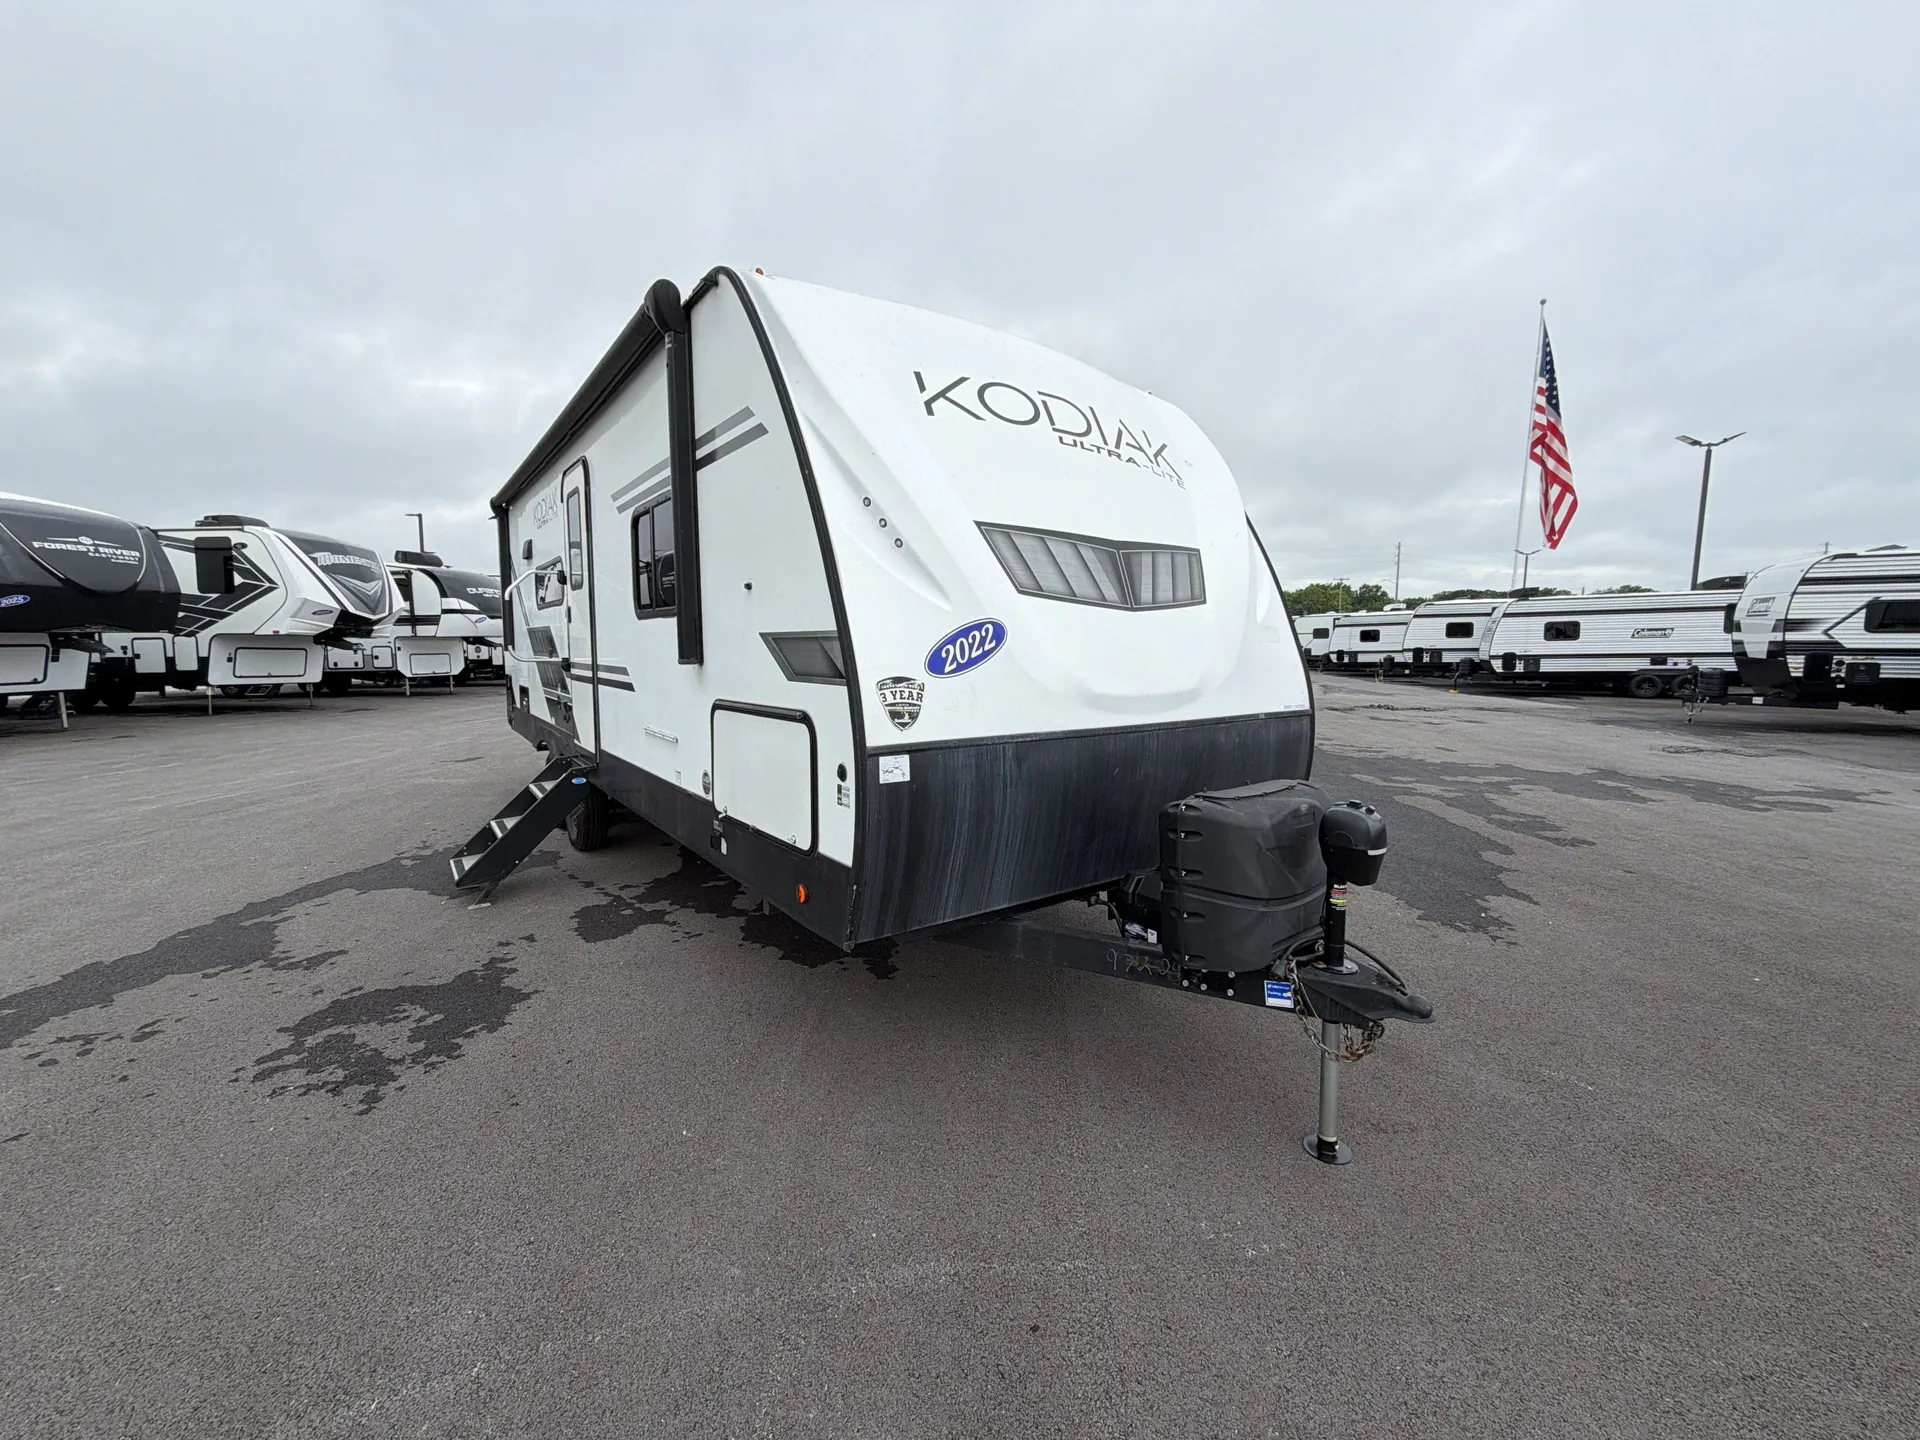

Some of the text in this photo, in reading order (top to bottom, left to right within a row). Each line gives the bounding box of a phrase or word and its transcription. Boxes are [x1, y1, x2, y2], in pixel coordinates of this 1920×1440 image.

[912, 370, 1182, 480] KODIAK
[1058, 435, 1186, 490] ULTRA-LITE
[533, 487, 559, 526] KODIAK
[31, 541, 140, 557] FOREST RIVER
[1, 595, 24, 607] 2025
[1634, 628, 1665, 637] Coleman
[941, 623, 996, 674] 2022
[879, 689, 924, 703] 3 YEAR
